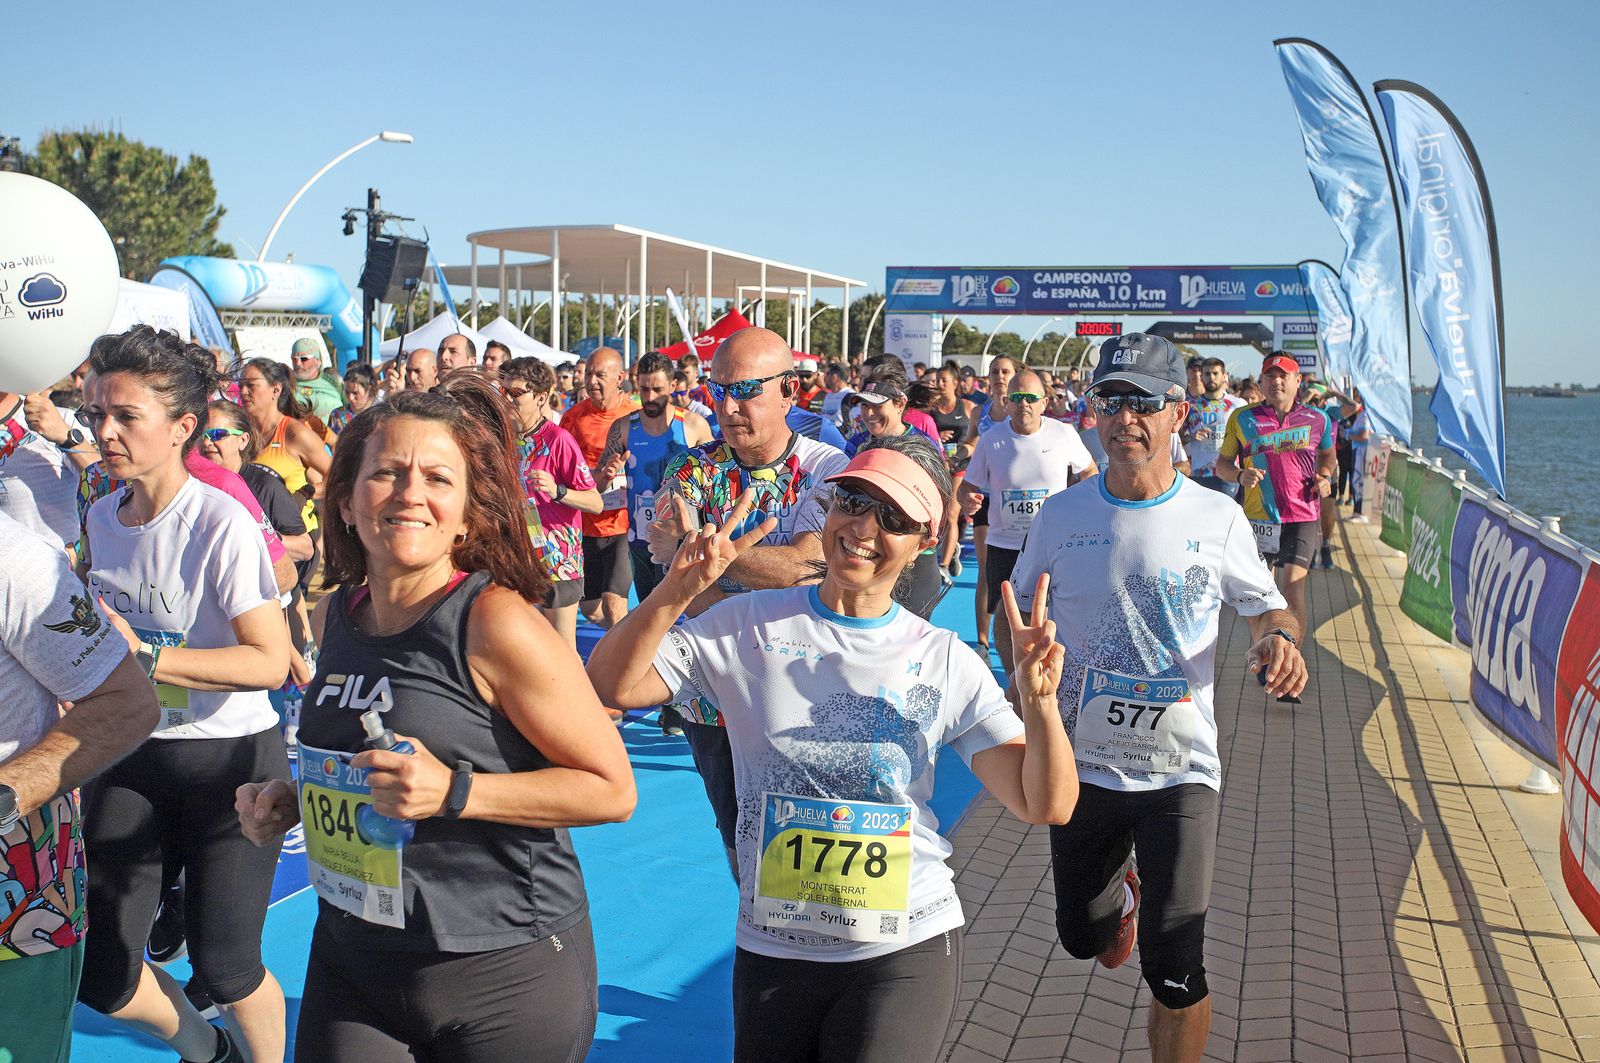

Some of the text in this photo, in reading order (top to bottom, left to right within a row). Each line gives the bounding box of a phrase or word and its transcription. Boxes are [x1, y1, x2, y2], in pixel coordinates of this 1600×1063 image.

[1033, 272, 1132, 284] CAMPEONATO
[1032, 284, 1167, 301] de ESPAÑA 10 km
[1205, 281, 1246, 294] HUELVA
[1281, 283, 1311, 296] WiH
[28, 308, 63, 321] WiHu
[1112, 349, 1141, 365] CAT
[1058, 539, 1111, 550] JORMA
[753, 642, 824, 660] JORMA
[72, 658, 82, 668] La
[316, 674, 394, 713] FILA
[1156, 686, 1184, 698] 2023
[1107, 701, 1166, 730] 577
[1113, 732, 1155, 742] FRANCISCO
[1108, 740, 1130, 748] ALEJO
[1085, 749, 1152, 762] HYUNDAI Syrluz
[794, 807, 827, 821] HUELVA
[862, 811, 900, 830] 2023
[833, 823, 851, 831] WiHu
[786, 834, 888, 879] 1778
[800, 880, 866, 895] MONTSERRAT
[797, 892, 868, 908] SOLER BERNAL
[768, 911, 857, 927] HYUNDAI Syrluz
